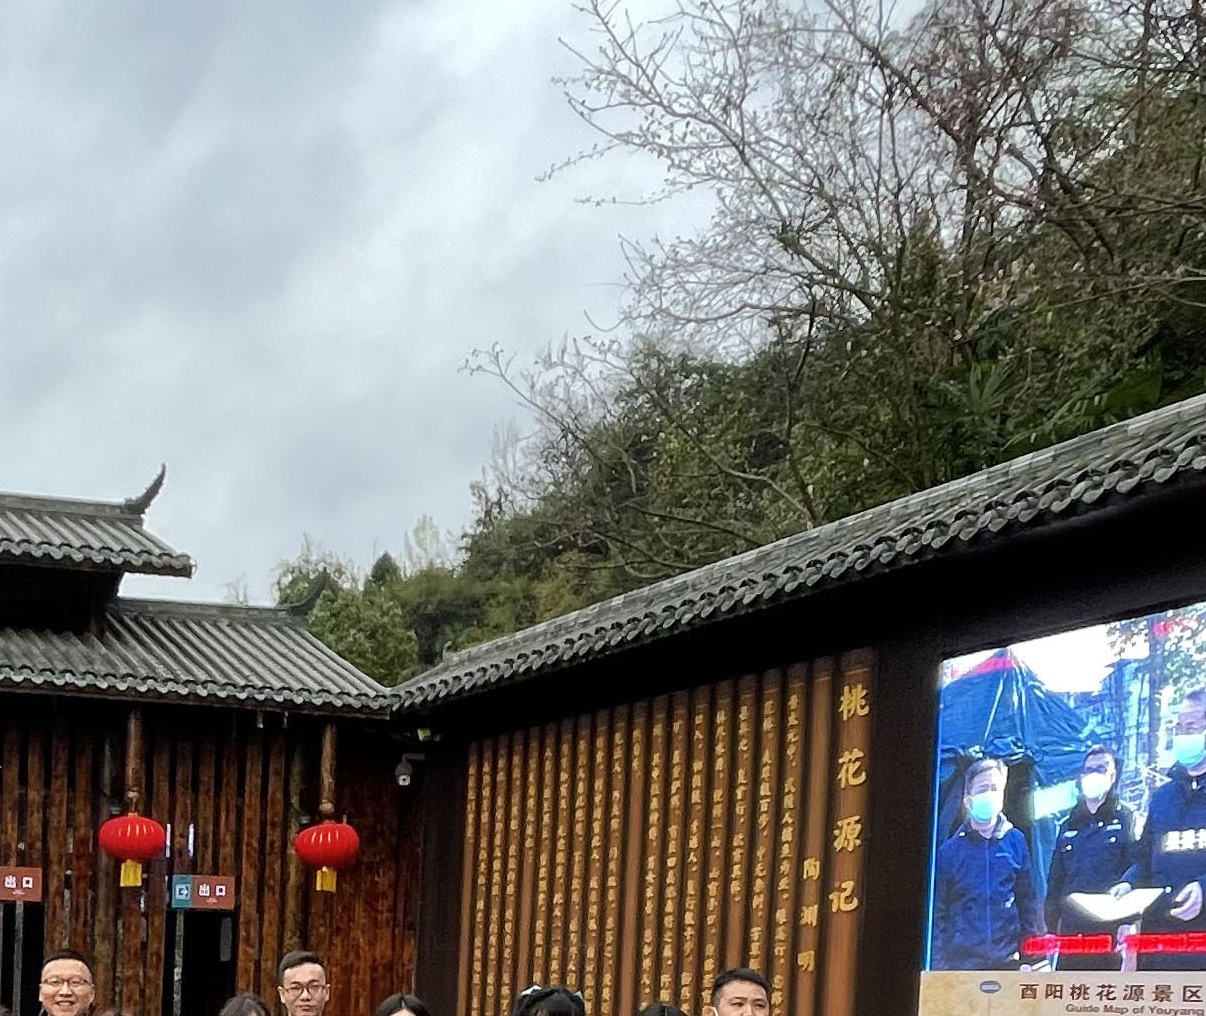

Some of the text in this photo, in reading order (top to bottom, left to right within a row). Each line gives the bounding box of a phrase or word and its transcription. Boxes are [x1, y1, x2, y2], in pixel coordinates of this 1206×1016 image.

[828, 684, 870, 913] 桃花源记
[4, 875, 34, 889] 出口
[198, 884, 226, 897] 出口
[797, 857, 821, 973] 陶渊明
[1019, 983, 1204, 1003] 酉阳桃花源景区
[1065, 1003, 1100, 1013] Guide
[1103, 1004, 1129, 1016] Map
[1132, 1004, 1145, 1015] of
